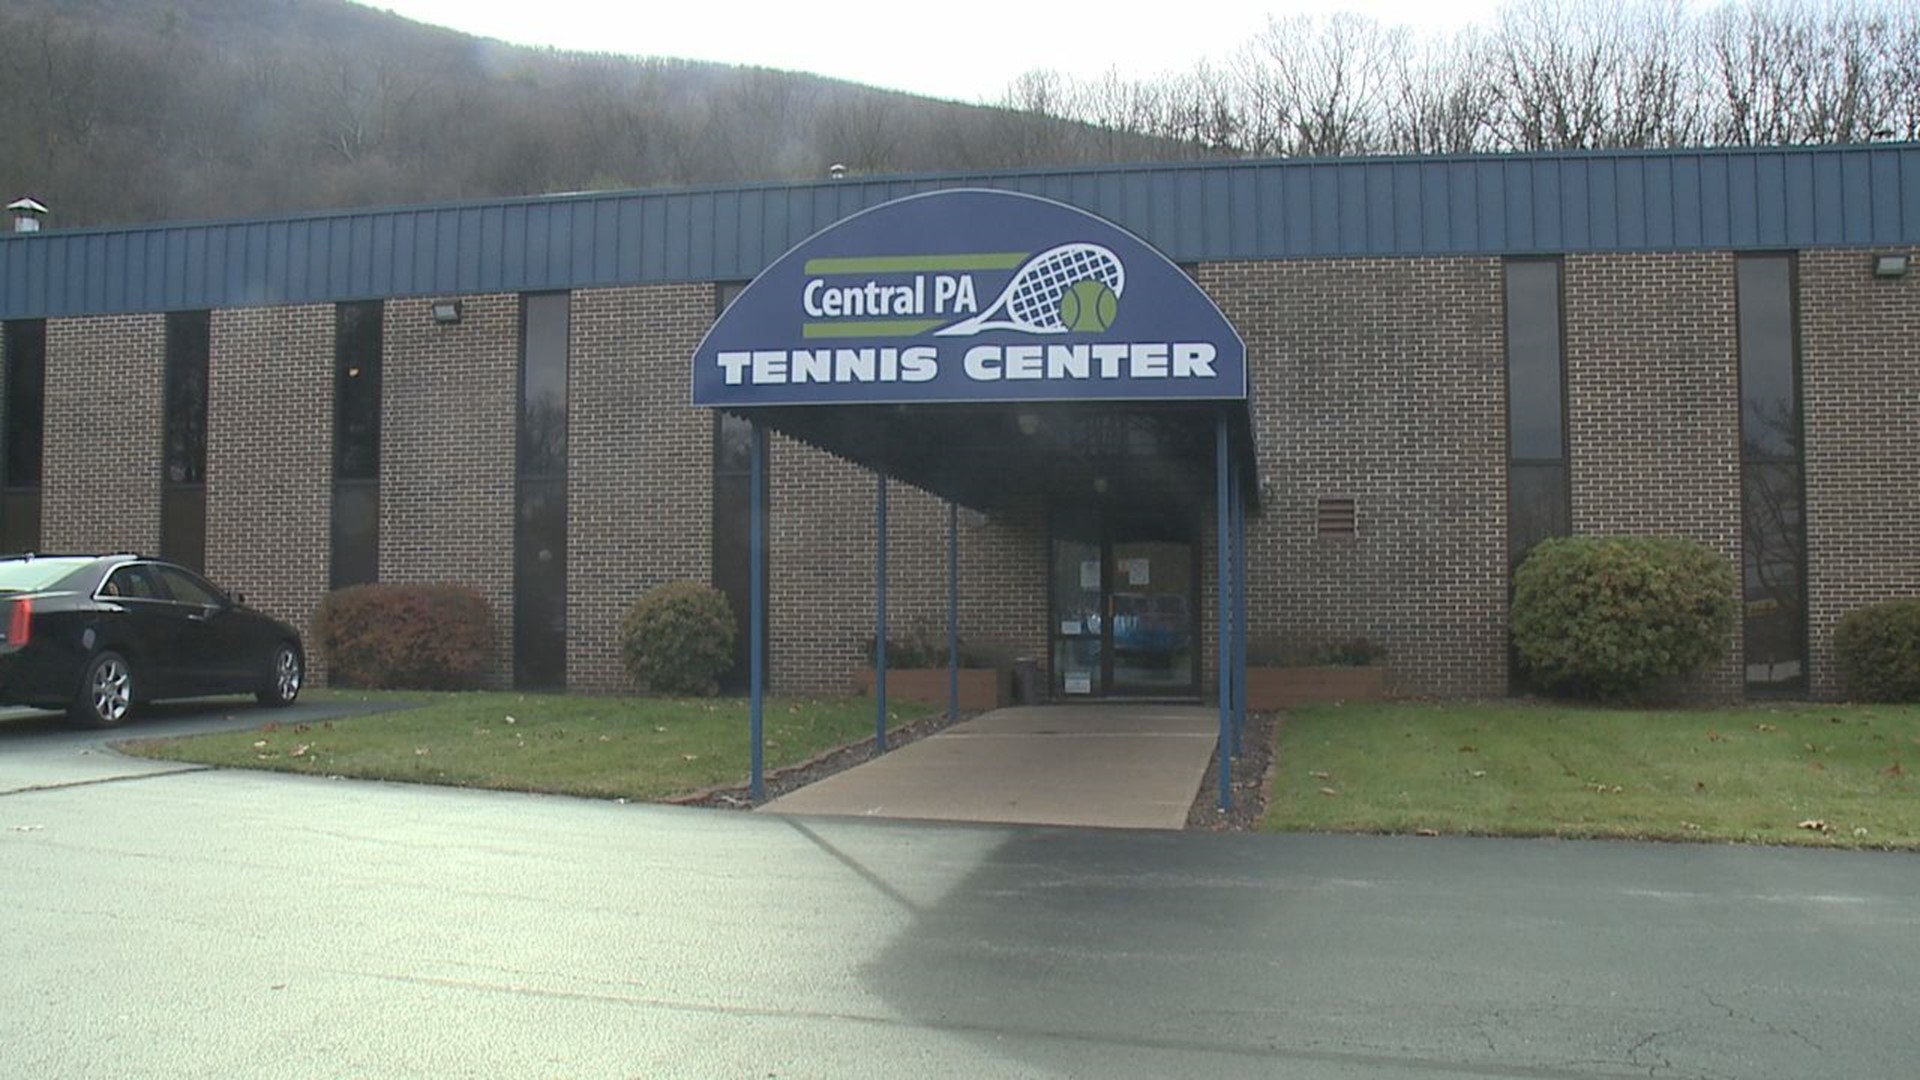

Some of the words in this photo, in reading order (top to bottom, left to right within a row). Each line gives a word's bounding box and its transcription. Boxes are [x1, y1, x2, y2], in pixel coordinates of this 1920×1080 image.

[803, 274, 924, 318] Central
[935, 274, 978, 314] PA
[717, 346, 938, 386] TENNIS
[964, 342, 1218, 381] CENTER
